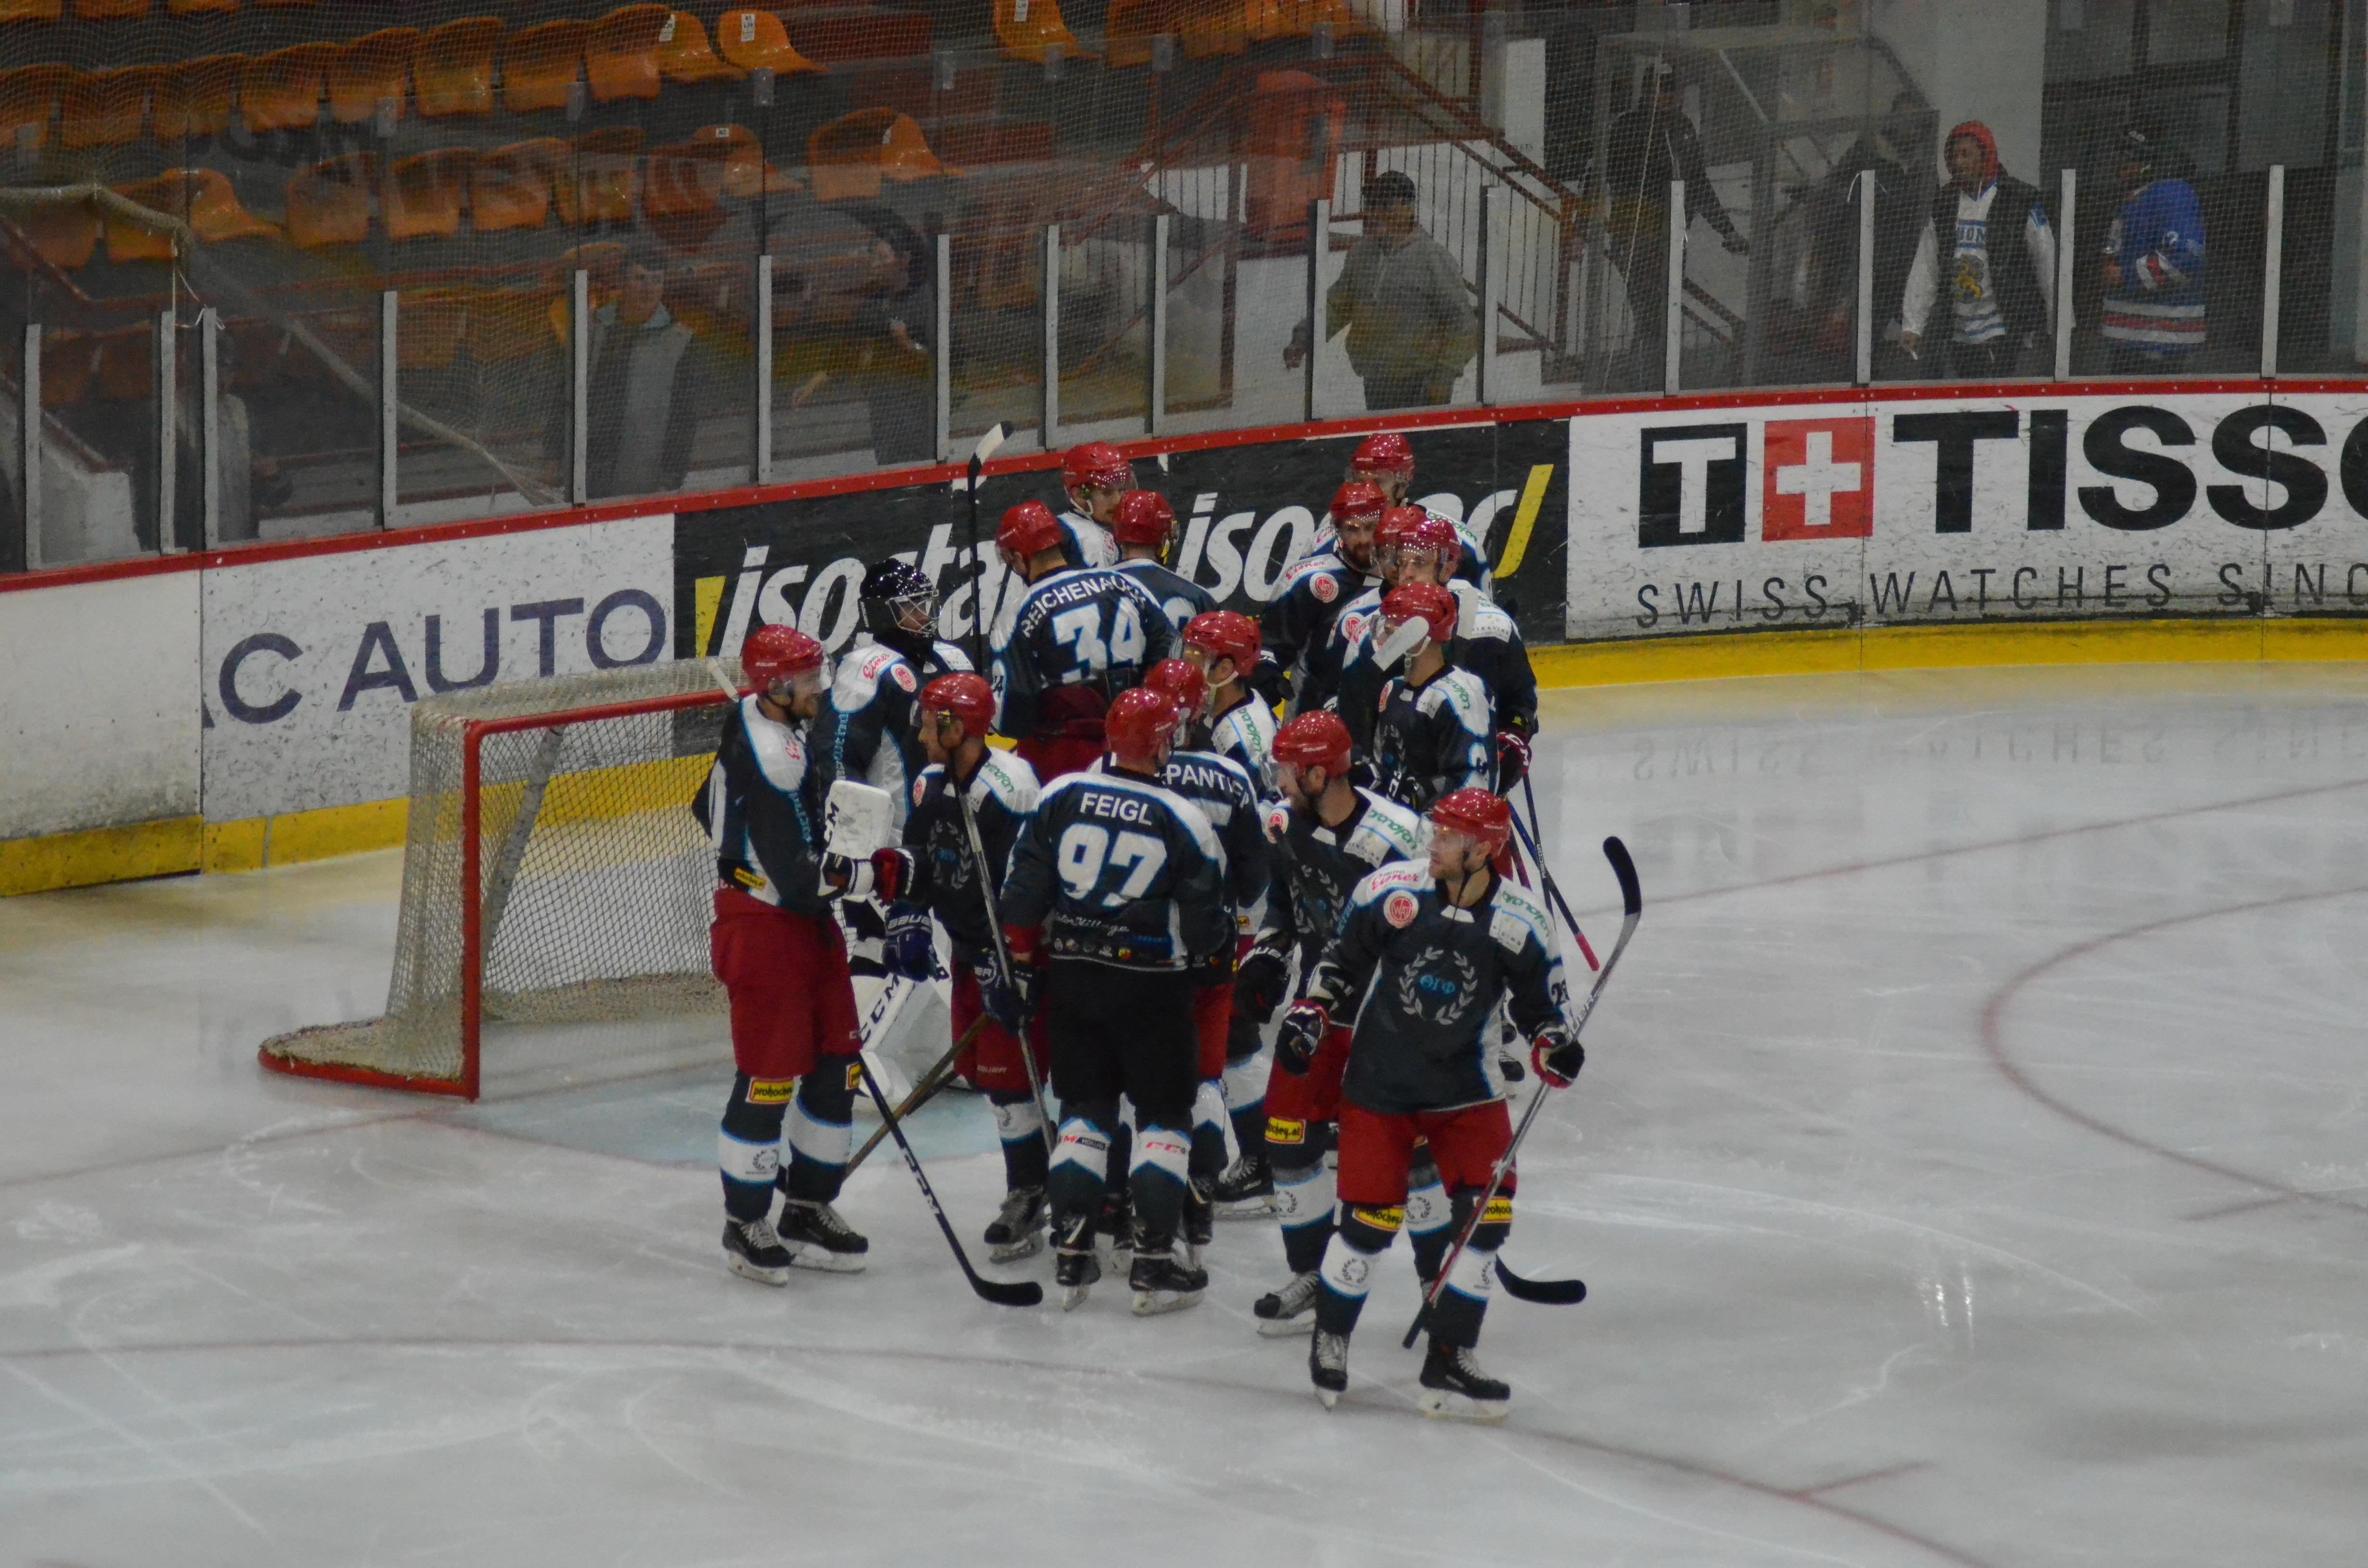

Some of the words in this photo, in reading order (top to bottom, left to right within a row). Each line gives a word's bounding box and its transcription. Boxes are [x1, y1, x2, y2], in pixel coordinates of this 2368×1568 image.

[1892, 405, 2368, 534] TISS
[1636, 574, 1830, 628] SWISS
[1870, 564, 2172, 615] WATCHES
[336, 588, 667, 711] AUTO
[1053, 597, 1147, 684] 34
[1079, 793, 1154, 826] FEIGL
[1057, 822, 1167, 907] 97
[888, 914, 931, 931] BAUE
